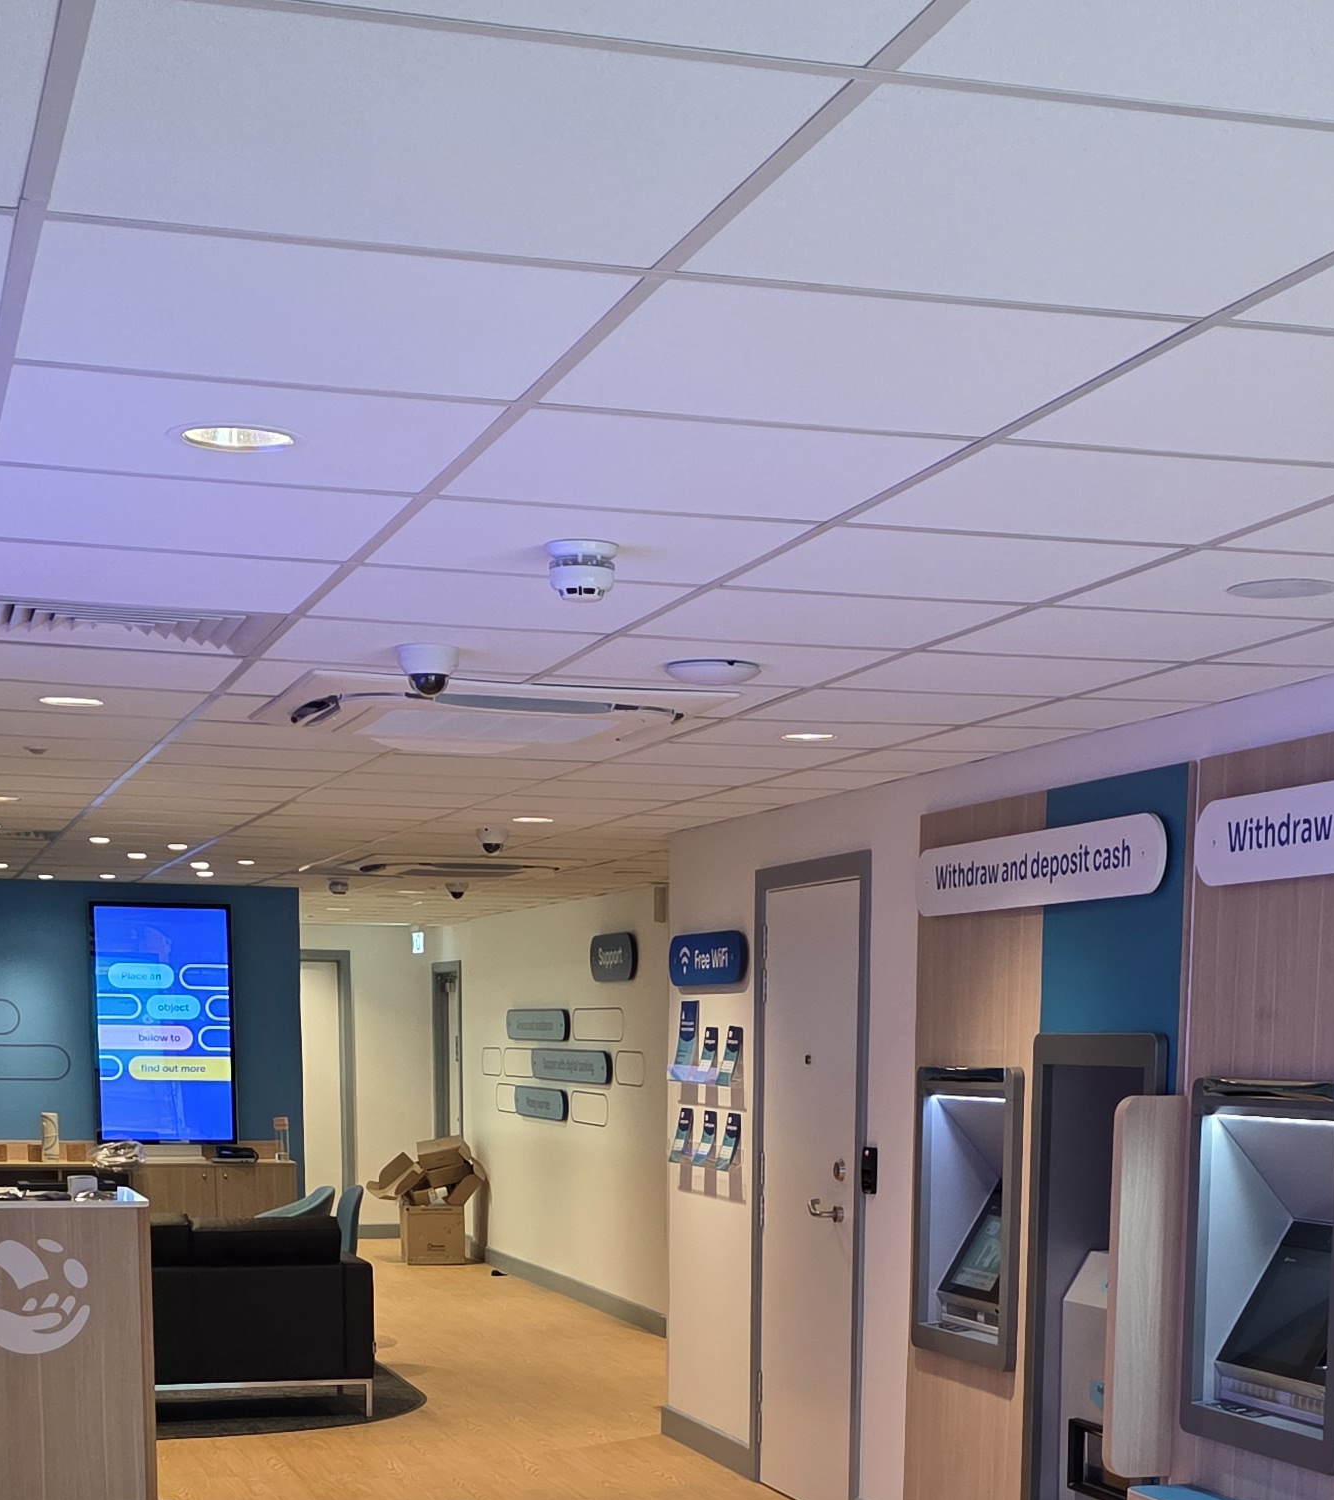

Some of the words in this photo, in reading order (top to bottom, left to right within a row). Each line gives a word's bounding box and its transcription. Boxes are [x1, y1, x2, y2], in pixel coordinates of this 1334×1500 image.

[1228, 813, 1333, 852] Withdraw
[935, 861, 999, 890] Withdraw
[1001, 853, 1028, 882] and
[1031, 844, 1090, 883] deposit
[1093, 838, 1131, 871] cash
[598, 947, 623, 969] Support
[694, 949, 710, 970] Free
[711, 947, 729, 968] WiFi
[121, 971, 148, 980] Place
[149, 972, 162, 980] an
[158, 1003, 189, 1013] object
[138, 1033, 168, 1042] below
[170, 1034, 181, 1042] to
[141, 1064, 160, 1073] find
[162, 1065, 178, 1073] out
